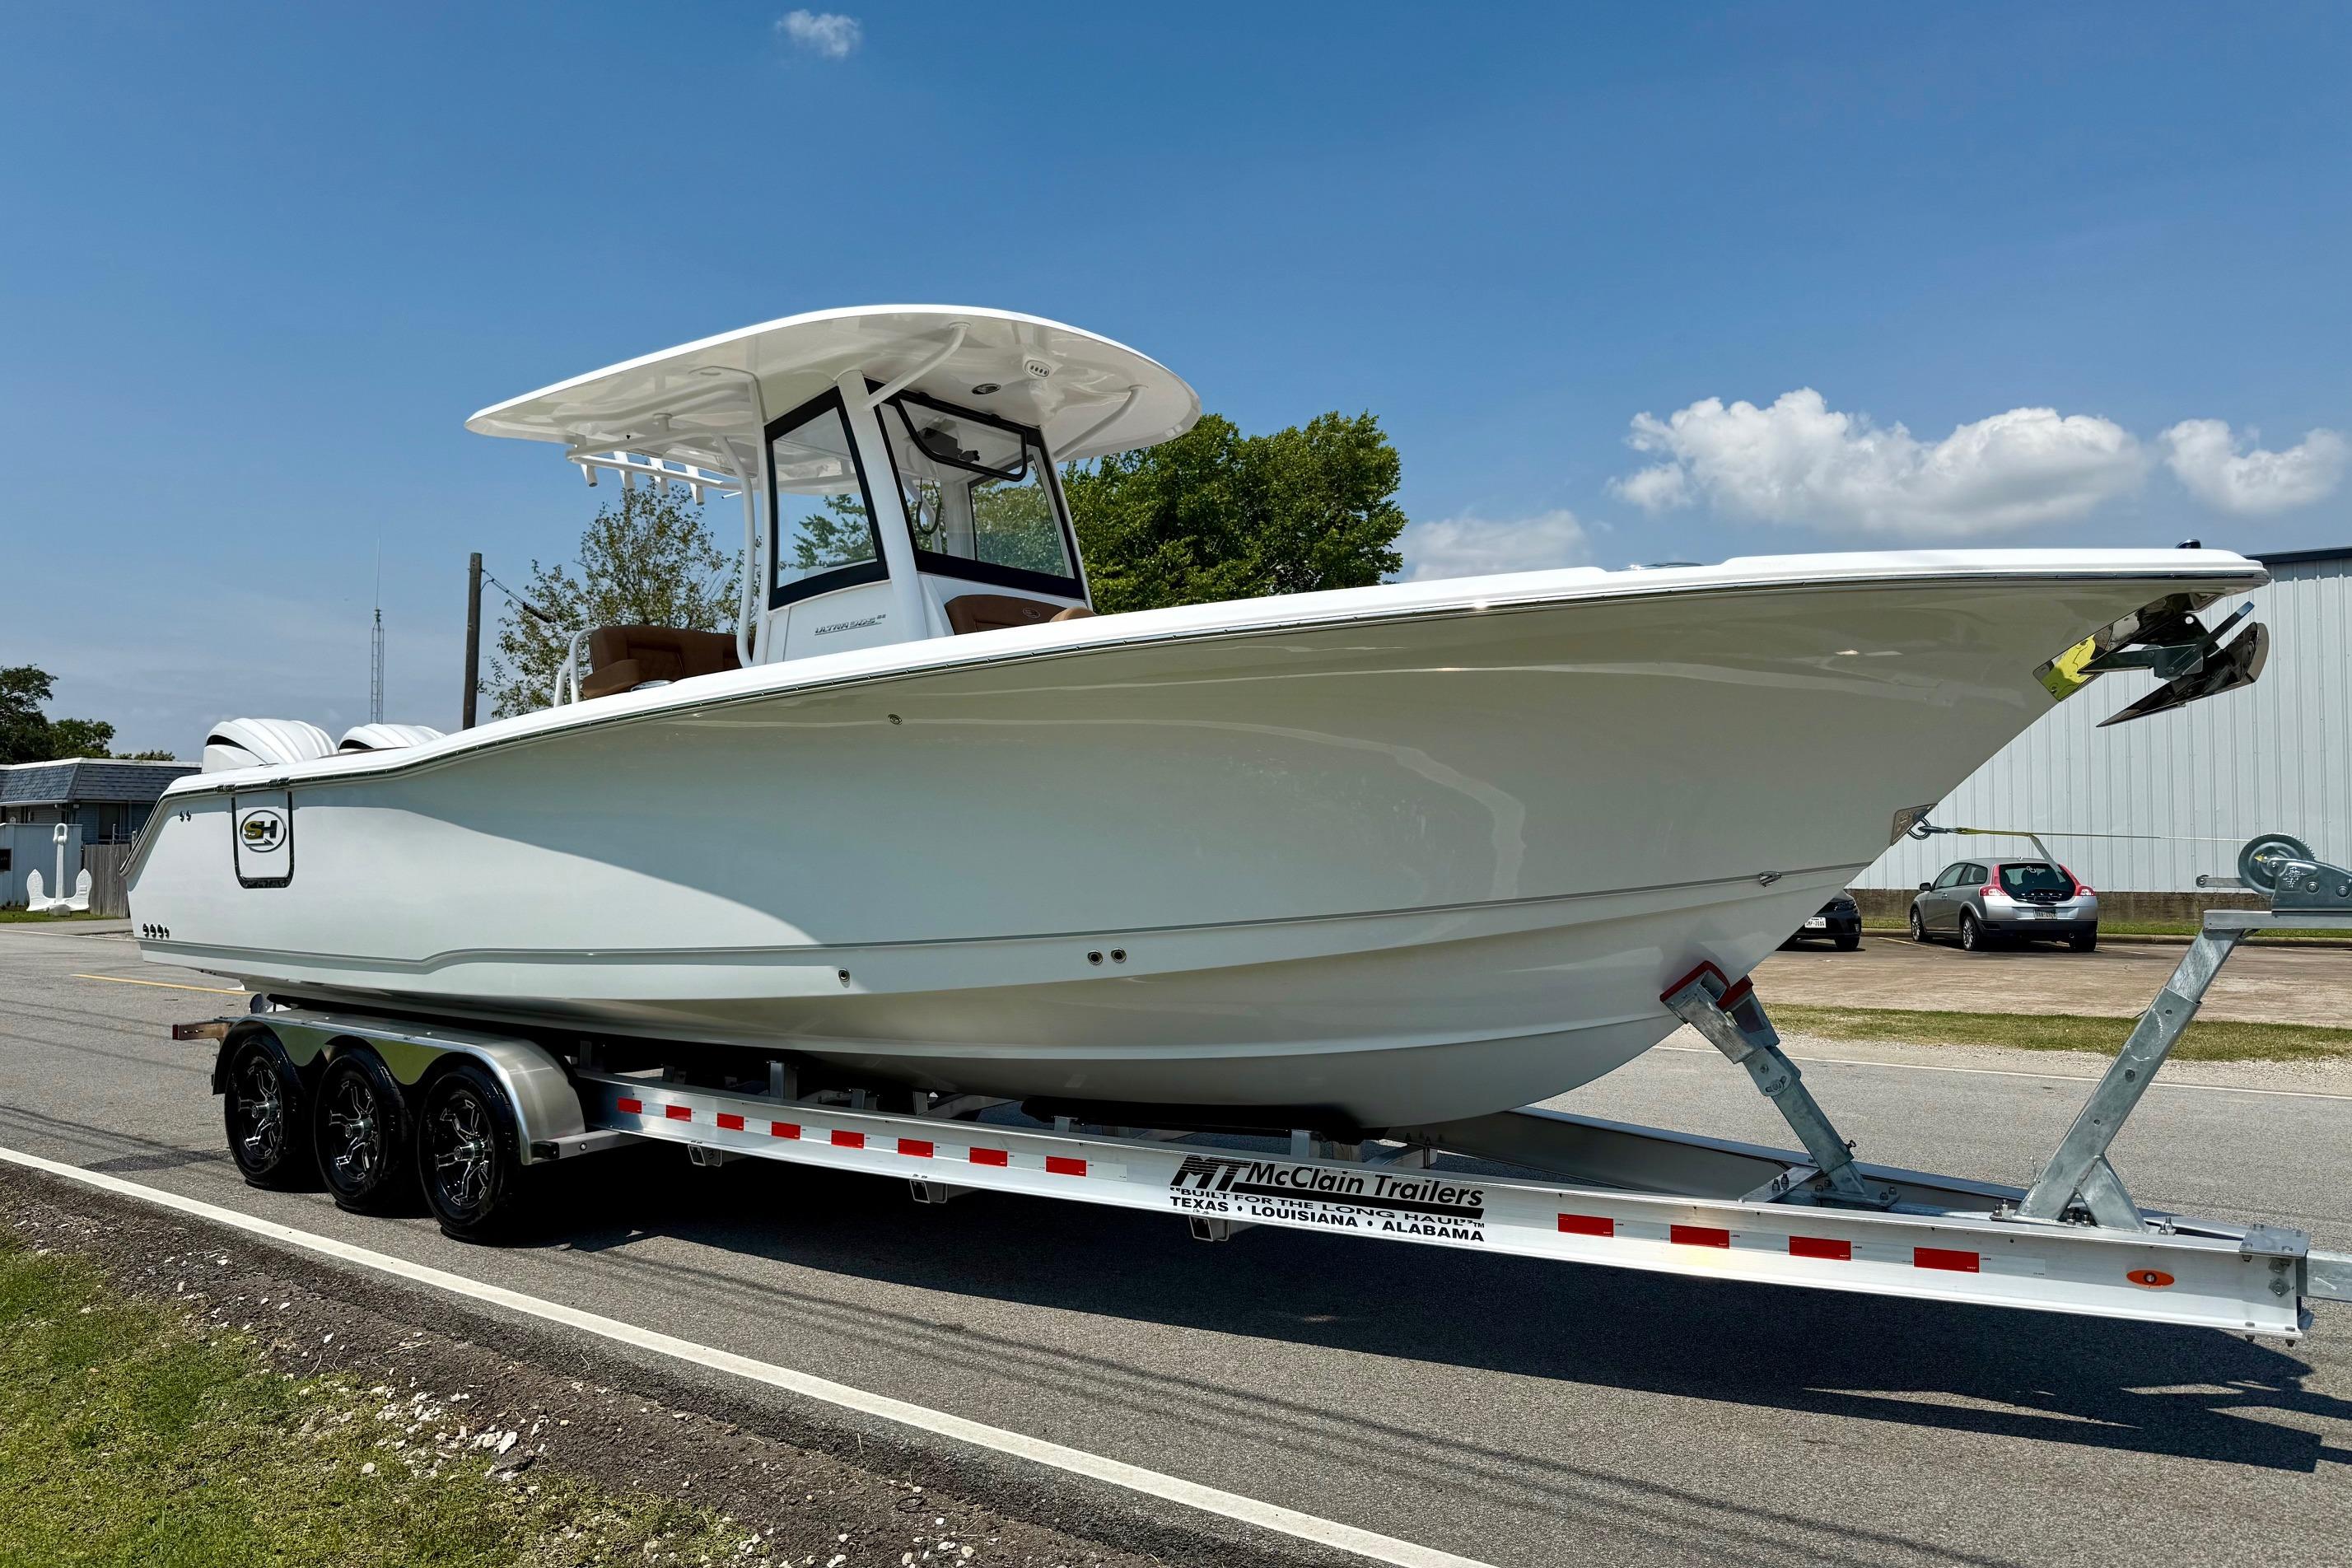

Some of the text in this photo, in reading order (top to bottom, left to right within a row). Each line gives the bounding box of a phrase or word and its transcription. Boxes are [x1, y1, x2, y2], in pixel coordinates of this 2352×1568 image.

[814, 622, 849, 633] ULTRA
[244, 819, 278, 840] SH
[1244, 1161, 1485, 1206] McClain Trailers
[1169, 1196, 1485, 1242] TEXAS LOUISIANA ALABAMA
[1234, 1194, 1273, 1205] FOR
[1277, 1199, 1314, 1209] THE
[1322, 1204, 1396, 1219] LONG
